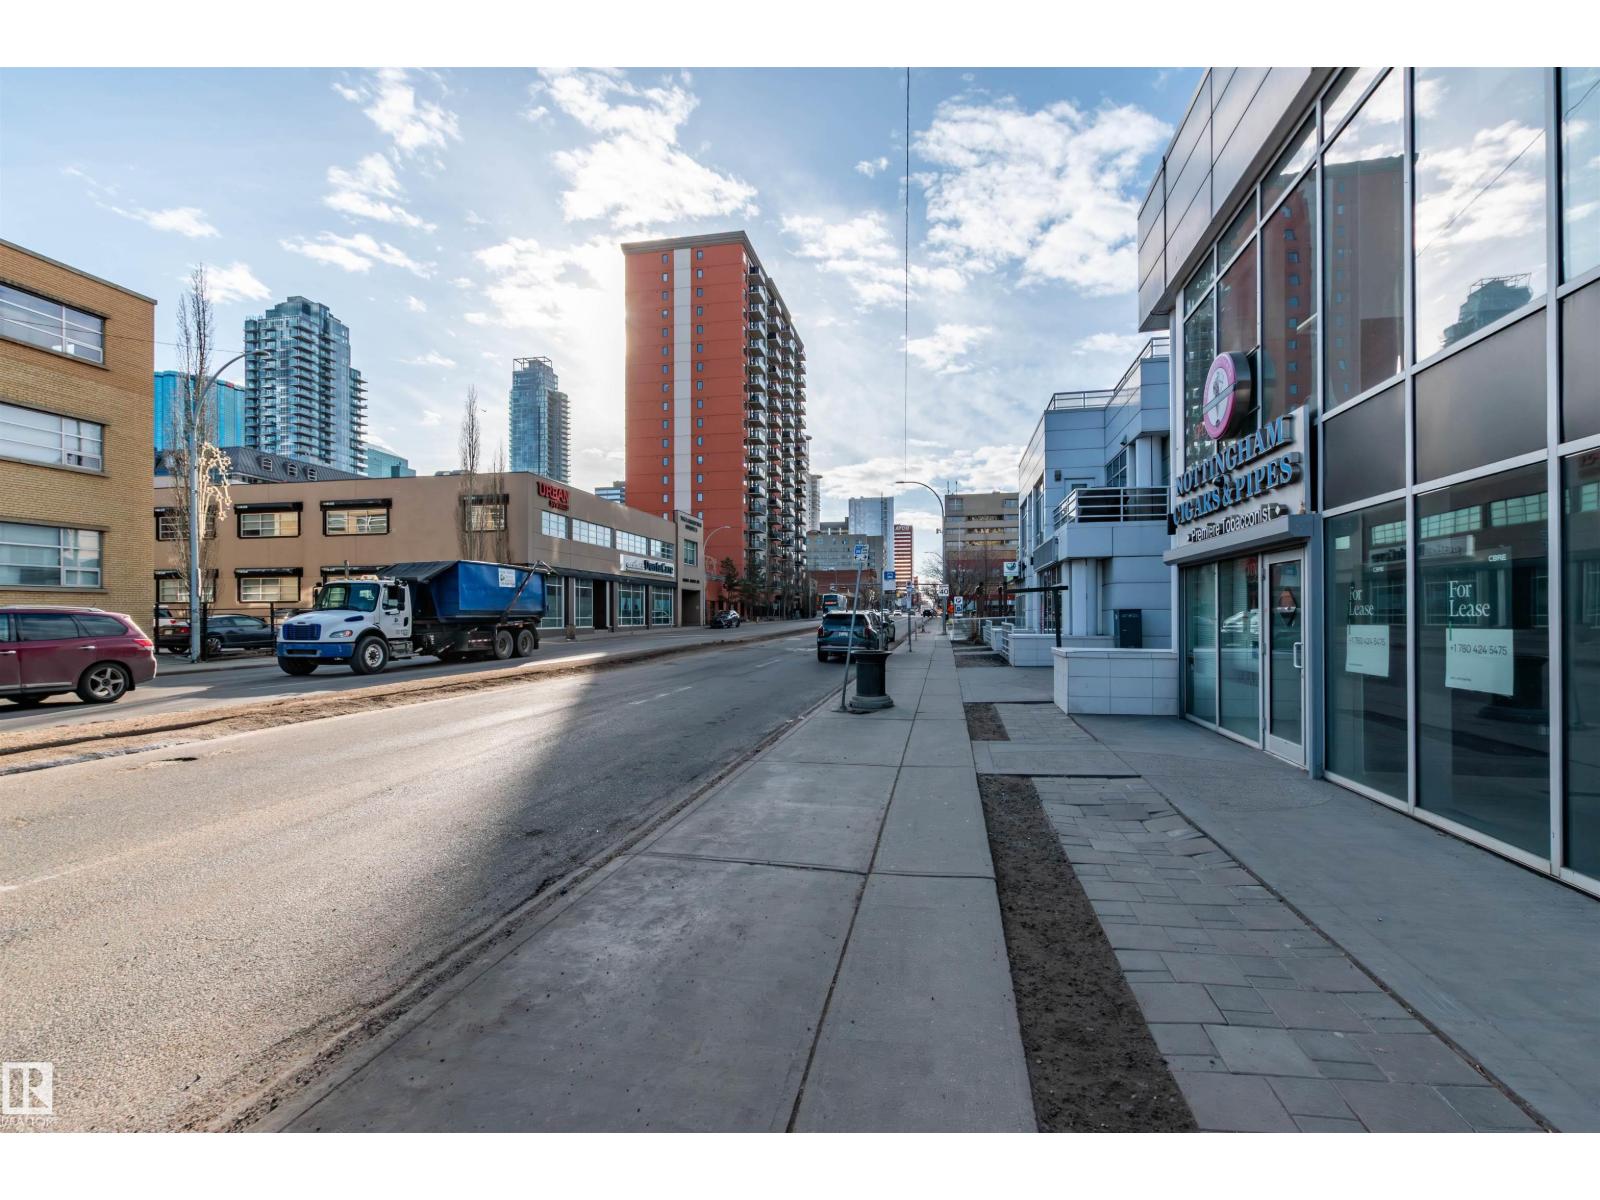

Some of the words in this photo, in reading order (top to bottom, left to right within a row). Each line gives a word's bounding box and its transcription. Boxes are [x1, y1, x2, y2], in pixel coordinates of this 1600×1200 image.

[1175, 415, 1286, 497] NOTTINGHAM
[537, 480, 569, 503] URBAN
[1173, 486, 1220, 526] CIGARS
[1221, 480, 1233, 507] &
[1234, 453, 1293, 501] PIPES
[1221, 503, 1272, 535] Tobacconist
[1488, 554, 1507, 562] CBRE
[1449, 580, 1472, 598] For
[1349, 602, 1374, 616] Lease
[1449, 599, 1490, 617] Lease
